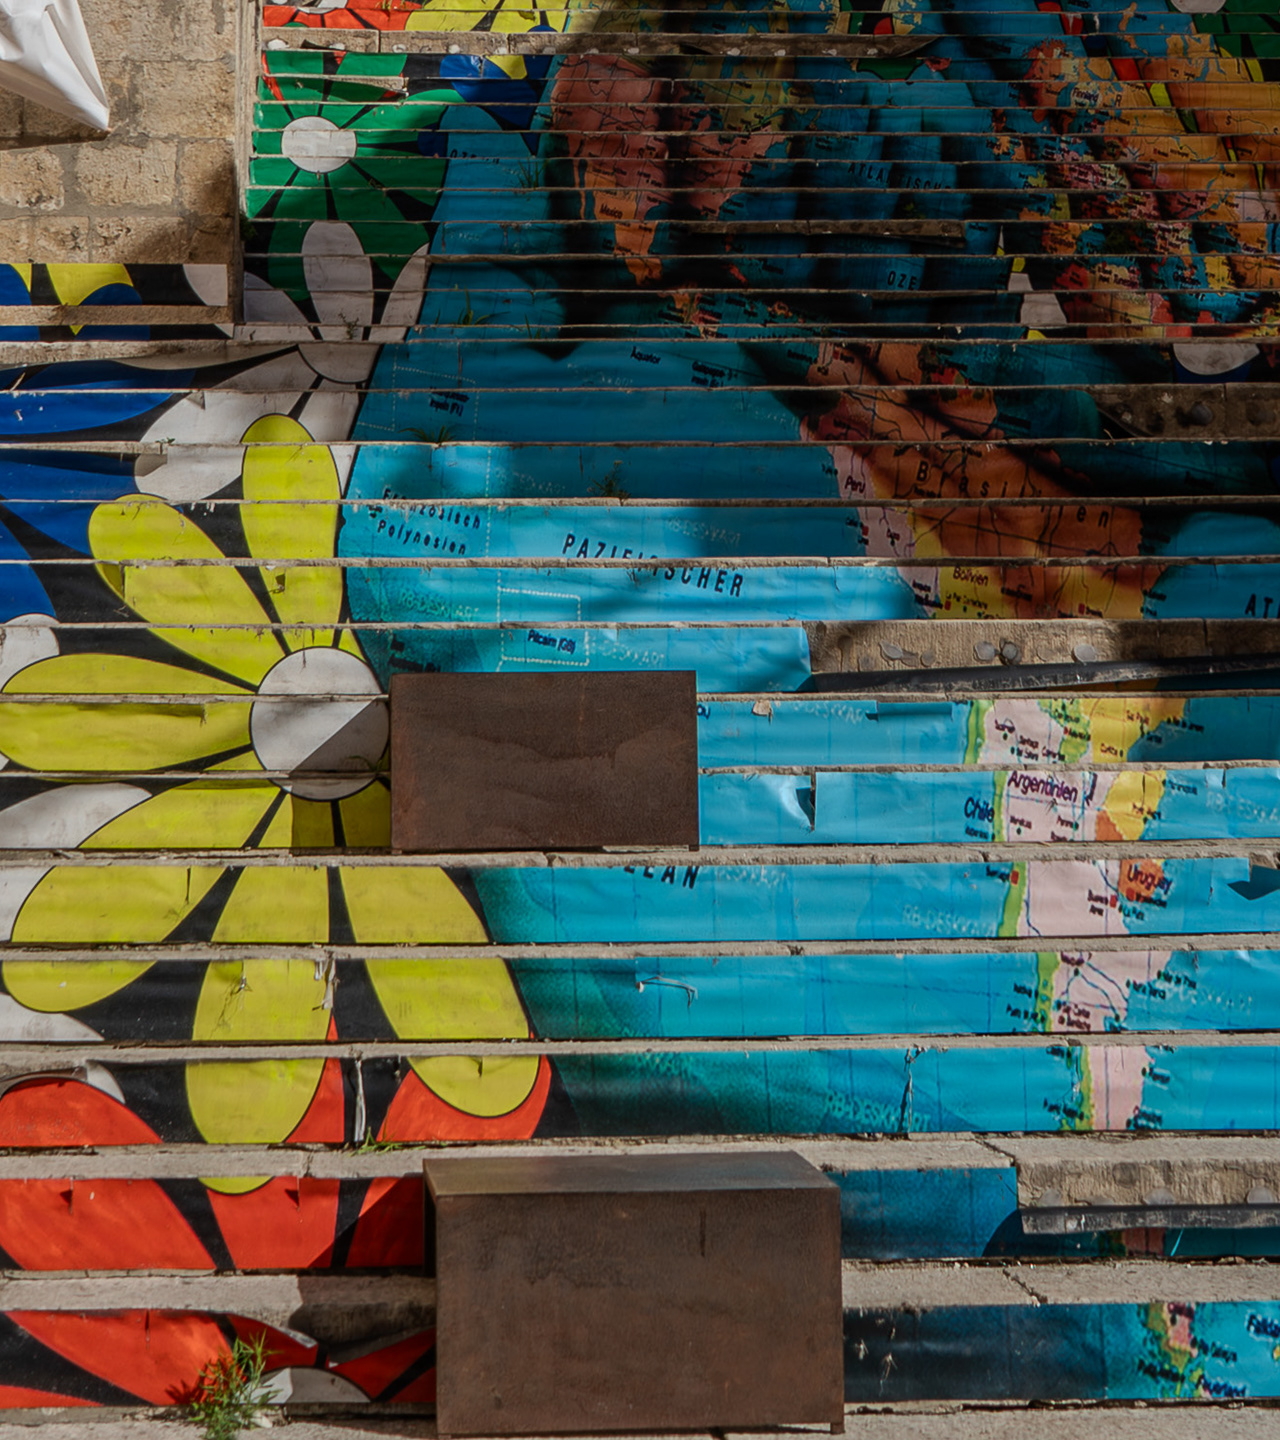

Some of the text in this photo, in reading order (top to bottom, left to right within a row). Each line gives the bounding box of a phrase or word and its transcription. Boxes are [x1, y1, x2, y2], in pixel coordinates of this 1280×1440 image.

[1072, 87, 1098, 104] Finnland
[600, 201, 624, 219] Mexico
[377, 519, 466, 556] Polynesien
[964, 795, 995, 823] Chile
[1128, 865, 1174, 895] Uruguay
